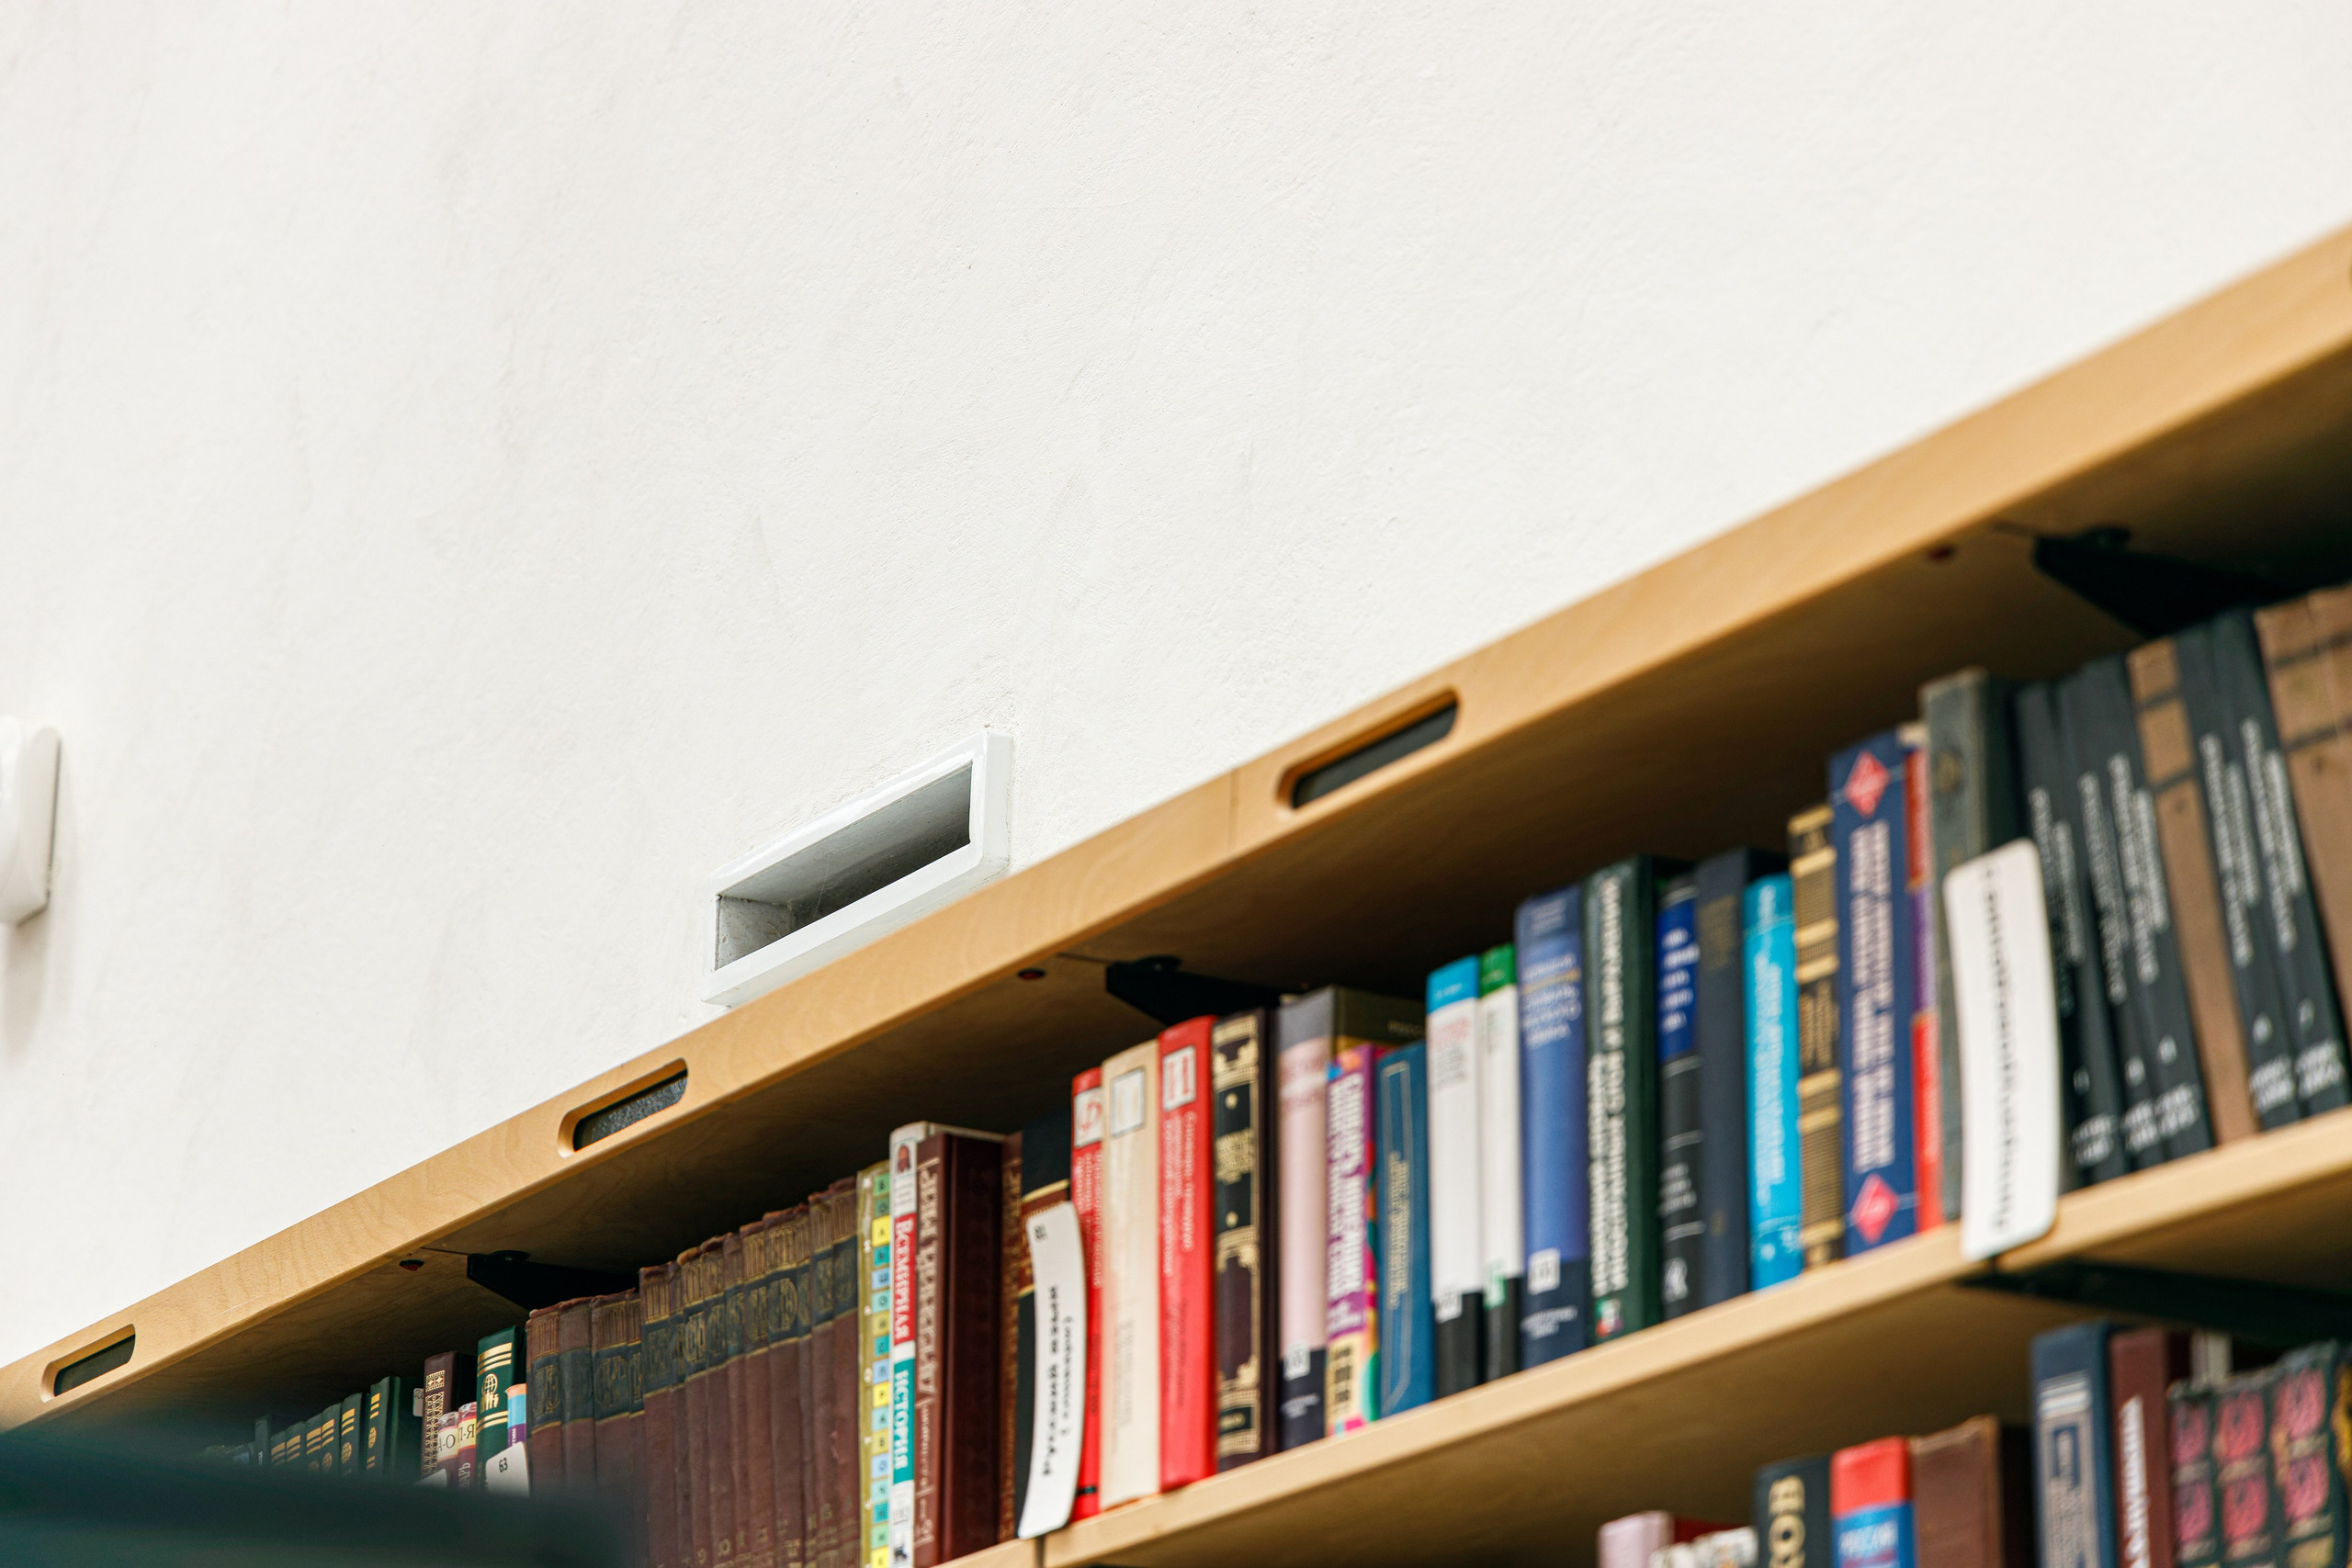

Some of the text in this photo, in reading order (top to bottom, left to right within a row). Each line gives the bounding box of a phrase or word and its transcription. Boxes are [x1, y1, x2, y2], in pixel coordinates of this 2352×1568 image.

[894, 1217, 914, 1339] ВСЕМИРНАЯ
[498, 1458, 508, 1472] 63
[893, 1370, 910, 1470] ИСТОРИЯ
